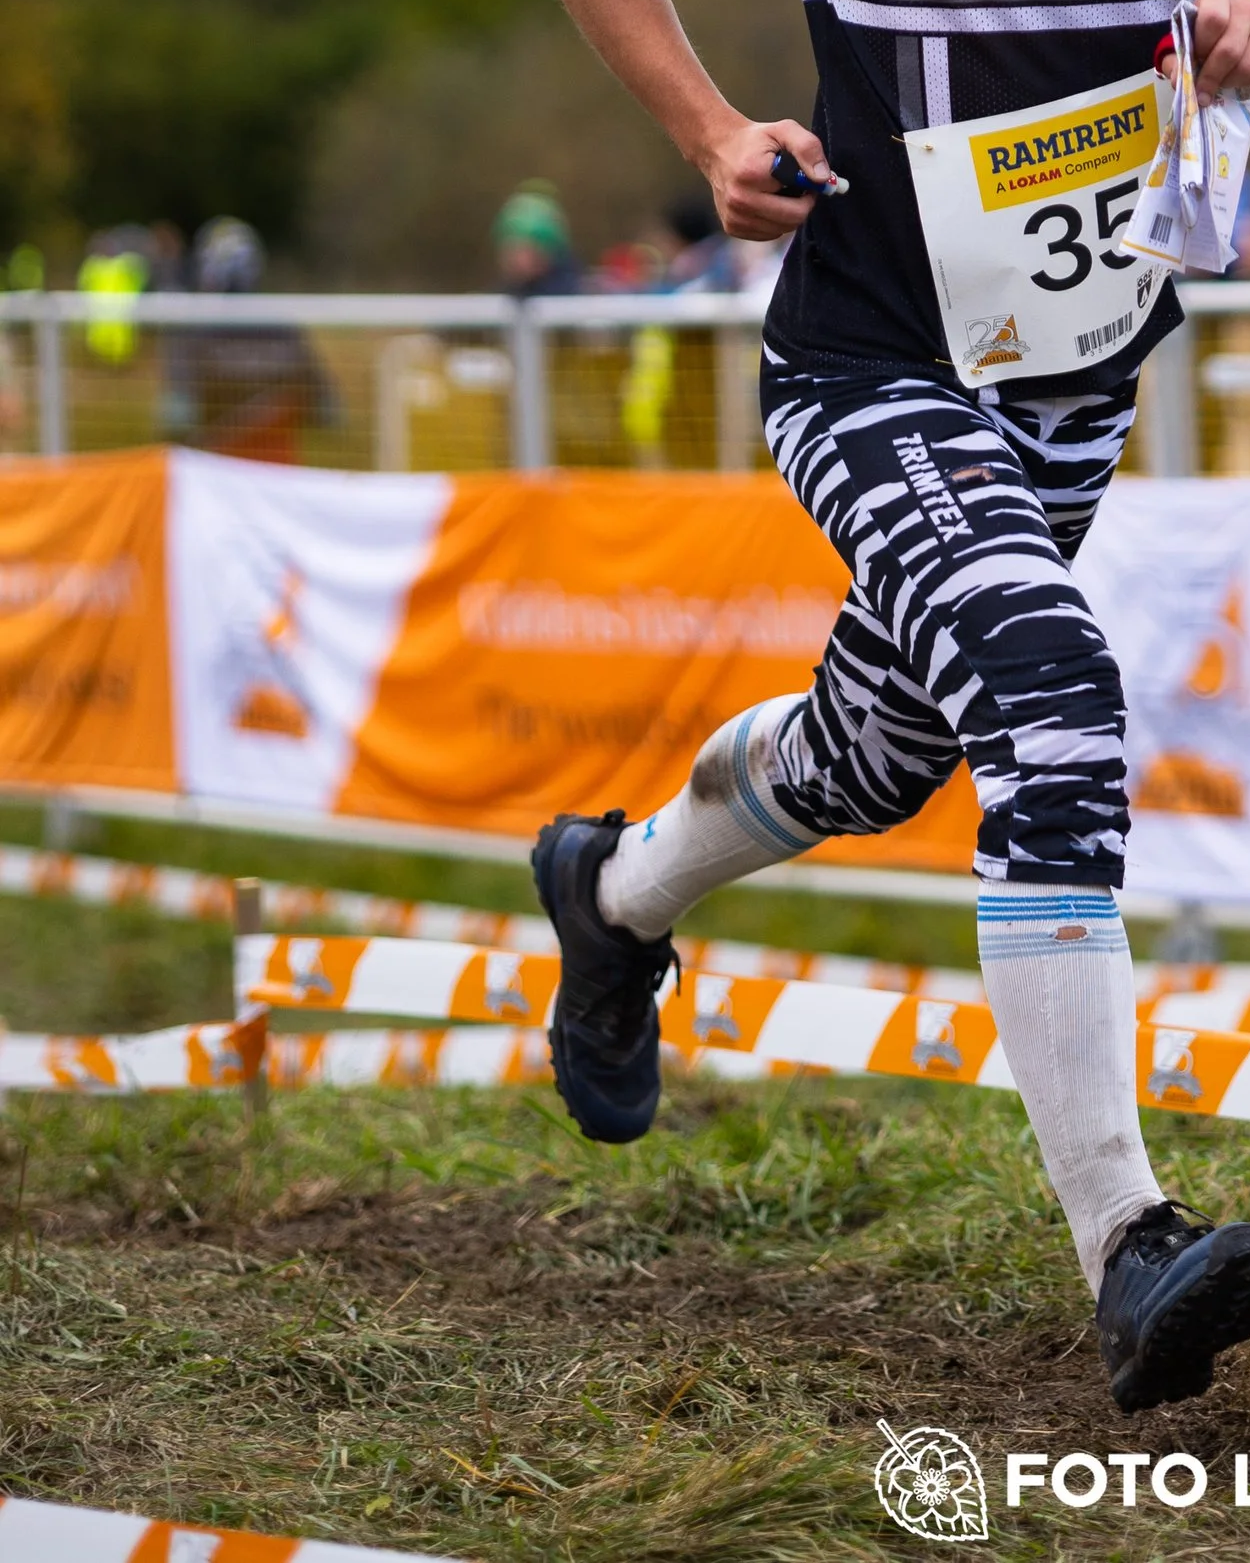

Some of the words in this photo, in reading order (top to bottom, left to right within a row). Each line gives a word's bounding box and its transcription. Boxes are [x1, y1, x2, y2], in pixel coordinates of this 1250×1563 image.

[987, 102, 1146, 175] RAMIRENT
[996, 181, 1007, 194] A
[1008, 168, 1063, 191] LOXAM
[1064, 150, 1122, 176] Company
[1023, 176, 1141, 292] 35
[968, 317, 1015, 348] 25
[892, 431, 975, 544] TRIMTEX
